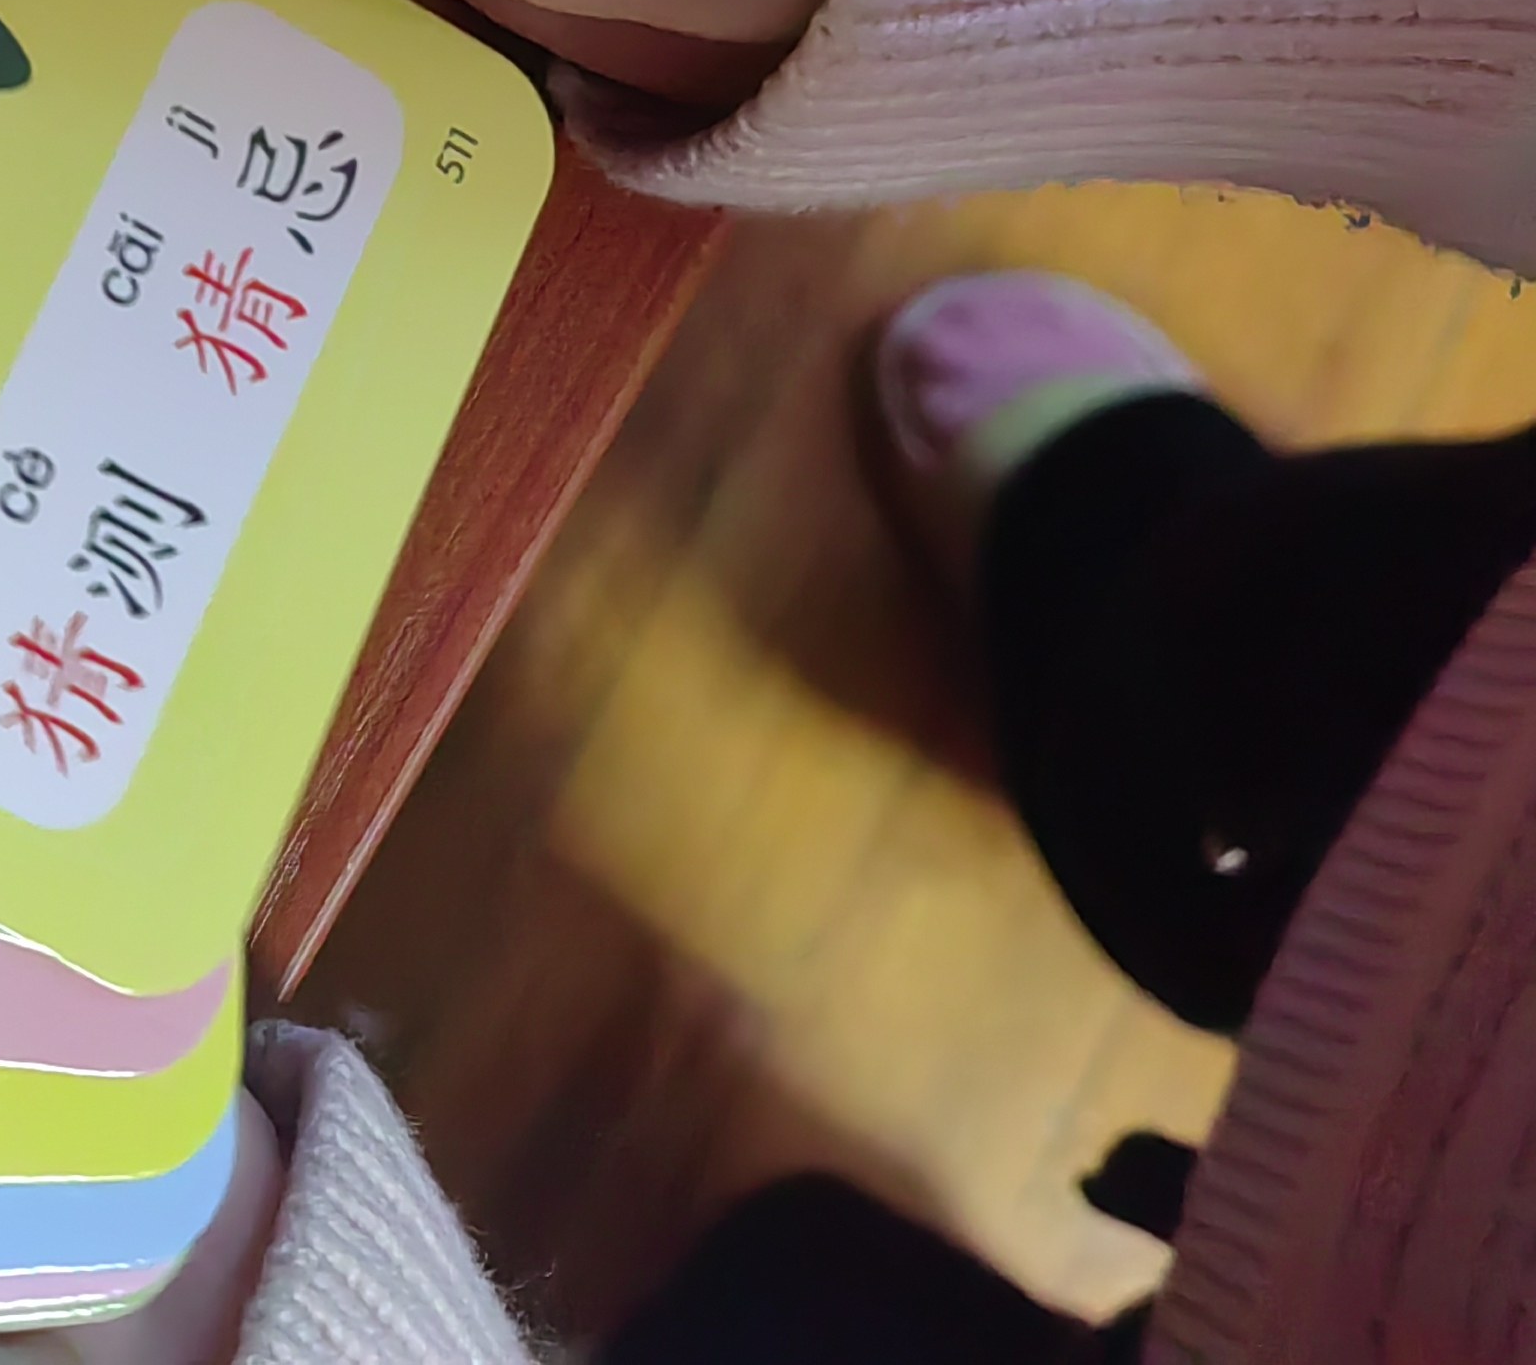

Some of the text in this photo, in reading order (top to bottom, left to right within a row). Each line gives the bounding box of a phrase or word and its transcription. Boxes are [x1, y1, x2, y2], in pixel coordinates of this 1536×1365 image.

[100, 212, 165, 308] cāi
[165, 104, 219, 160] jì
[436, 126, 480, 186] 511
[174, 128, 360, 397] 猜忌
